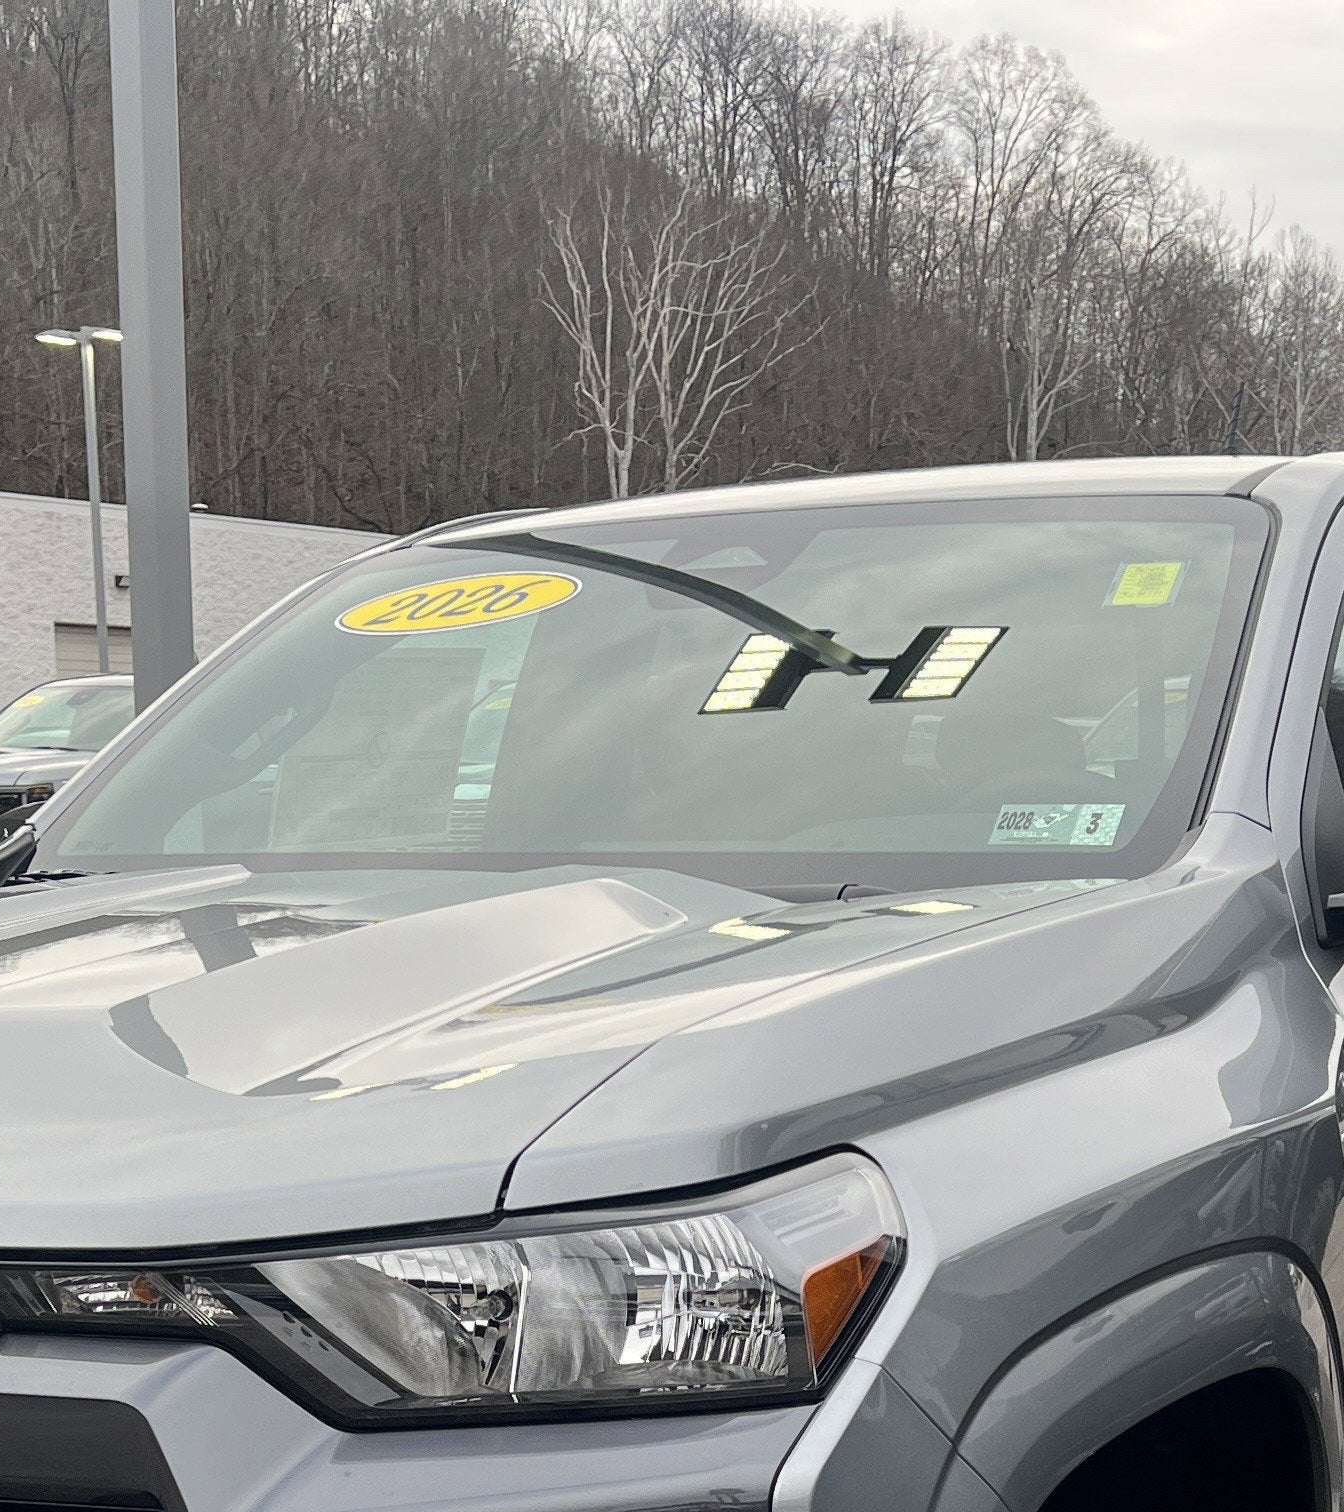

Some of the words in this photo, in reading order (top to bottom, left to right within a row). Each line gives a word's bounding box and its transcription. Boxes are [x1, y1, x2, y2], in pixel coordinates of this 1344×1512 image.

[362, 579, 552, 627] 2026
[997, 811, 1035, 831] 2028
[1085, 812, 1104, 835] 3
